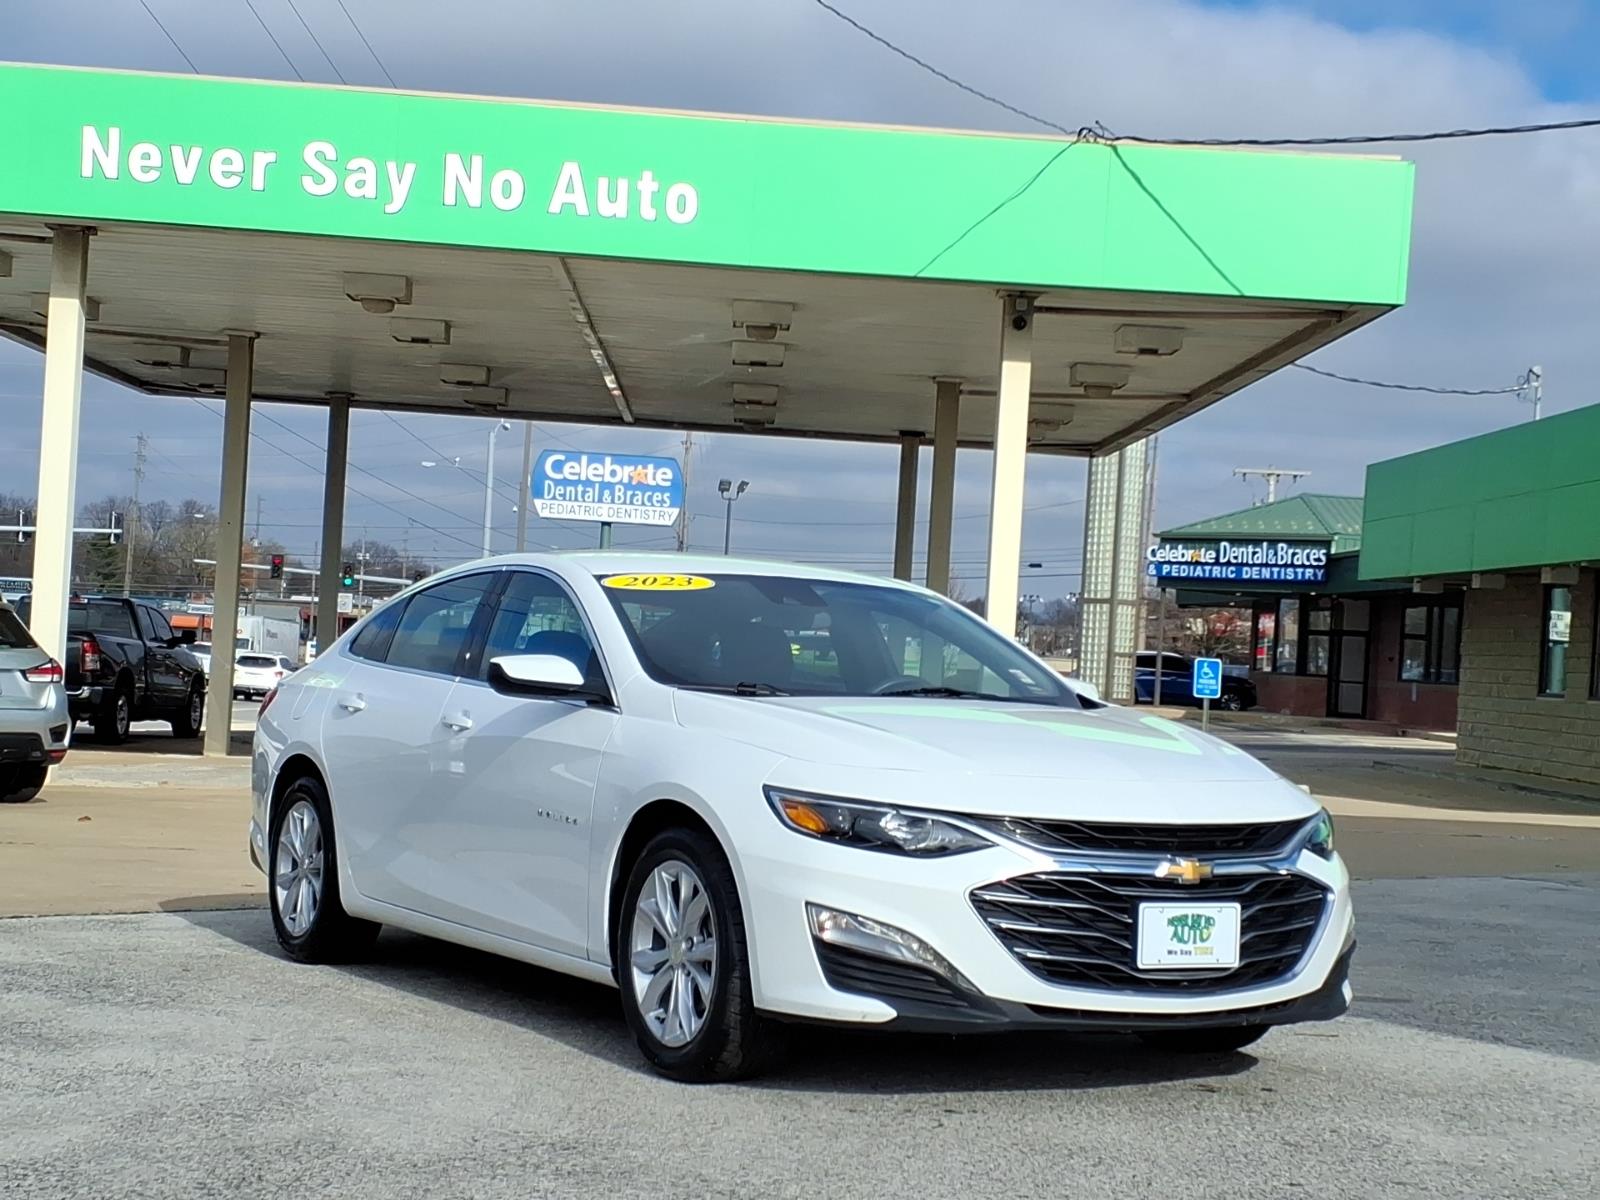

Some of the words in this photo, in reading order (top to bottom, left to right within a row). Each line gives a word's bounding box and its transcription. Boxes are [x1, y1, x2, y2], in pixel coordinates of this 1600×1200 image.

[80, 124, 278, 193] Never
[300, 140, 417, 215] Say
[442, 152, 526, 212] No
[548, 161, 699, 225] Auto
[544, 454, 673, 487] Celebrte
[543, 480, 599, 502] Dental
[602, 489, 612, 504] &
[614, 485, 671, 506] Braces
[540, 503, 604, 517] PEDIATRIC
[607, 507, 674, 522] DENTISTRY
[1147, 545, 1217, 563] Celebrte
[623, 576, 694, 586] 2023
[1148, 564, 1157, 575] &
[1162, 564, 1237, 578] PEDIATRIC
[1243, 567, 1325, 580] DENTISTRY
